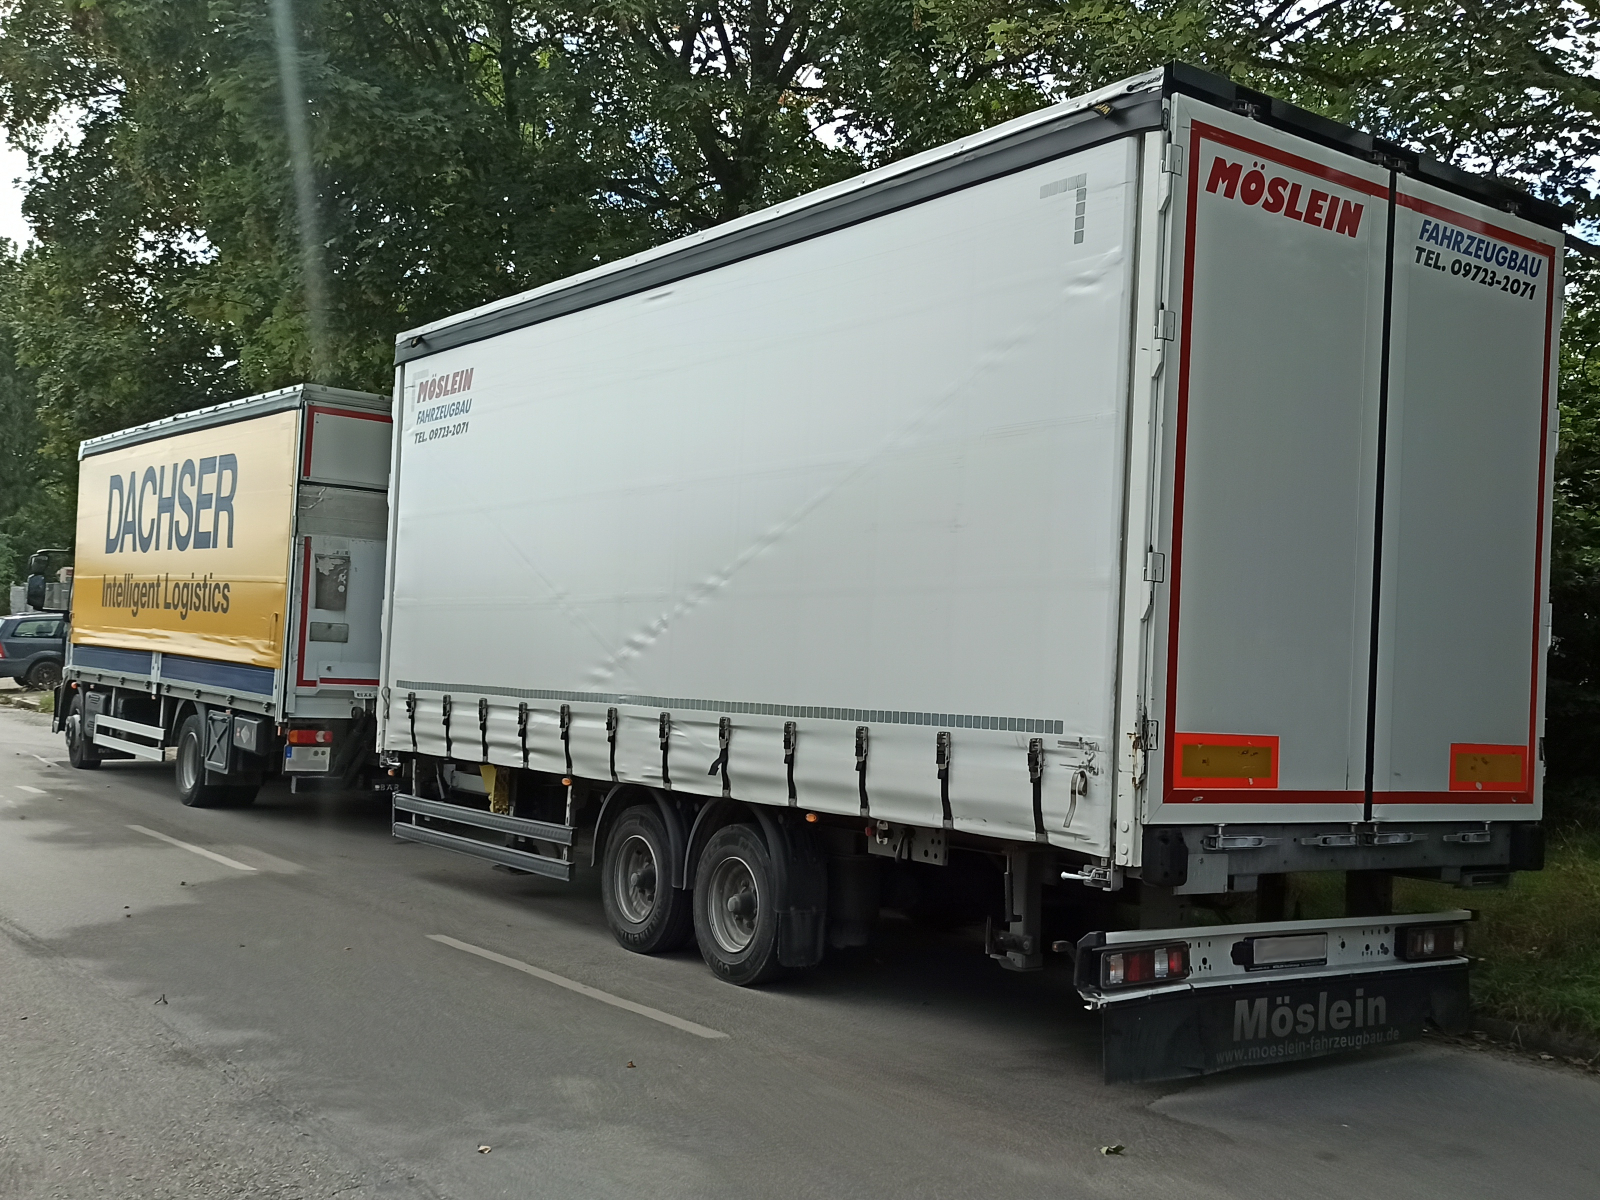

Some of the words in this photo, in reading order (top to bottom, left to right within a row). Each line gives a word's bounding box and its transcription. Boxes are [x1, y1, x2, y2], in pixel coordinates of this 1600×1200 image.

[1205, 155, 1364, 239] MÖSLEIN
[1414, 245, 1446, 273] TEL.
[1450, 257, 1537, 301] 09723-2071
[1418, 218, 1543, 278] FAHRZEUGBAU
[416, 367, 475, 404] MÖSLEIN
[414, 430, 428, 445] TEL.
[416, 398, 473, 426] FAHRZEUGBAU
[105, 453, 238, 554] DACHSER
[101, 572, 161, 618] Intelligent
[163, 571, 231, 621] Logistics
[1232, 987, 1387, 1042] Möslein
[1215, 1026, 1400, 1065] www.moeslein-fahrzeugbau.de
